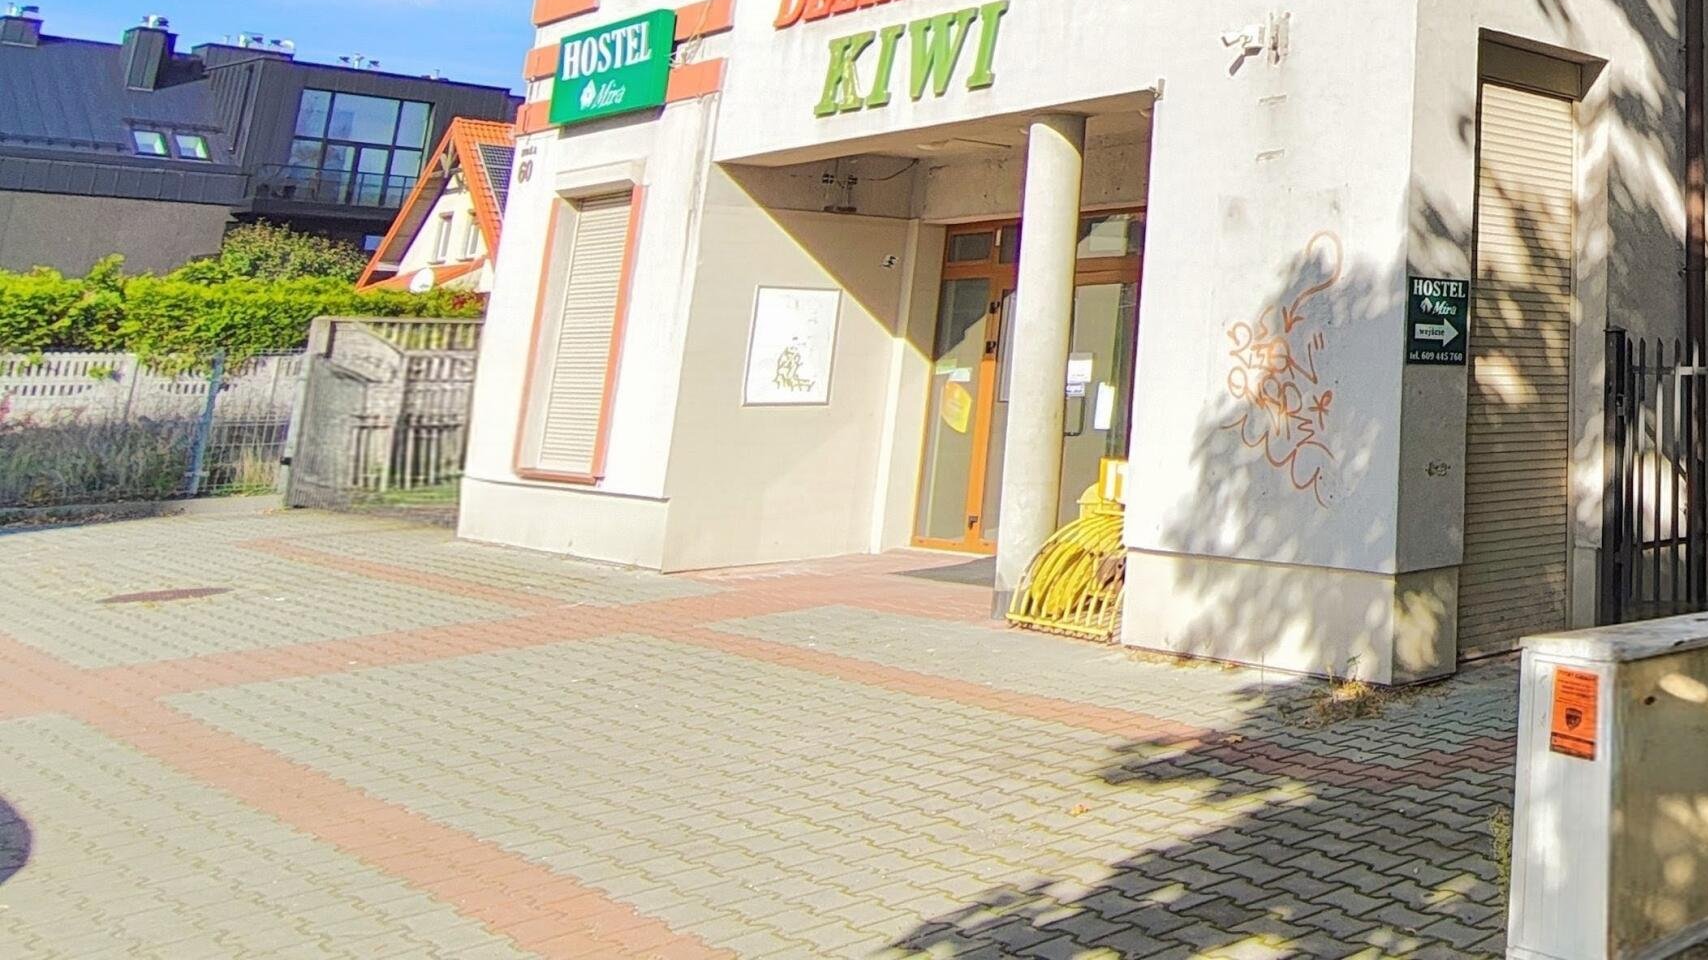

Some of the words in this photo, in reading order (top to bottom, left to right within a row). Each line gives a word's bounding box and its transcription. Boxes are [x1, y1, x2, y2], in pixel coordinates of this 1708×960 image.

[561, 21, 652, 81] HOSTEL
[814, 0, 1011, 118] KIWI
[517, 159, 534, 185] 60
[1413, 279, 1466, 298] HOSTEL
[1432, 300, 1457, 315] Mira
